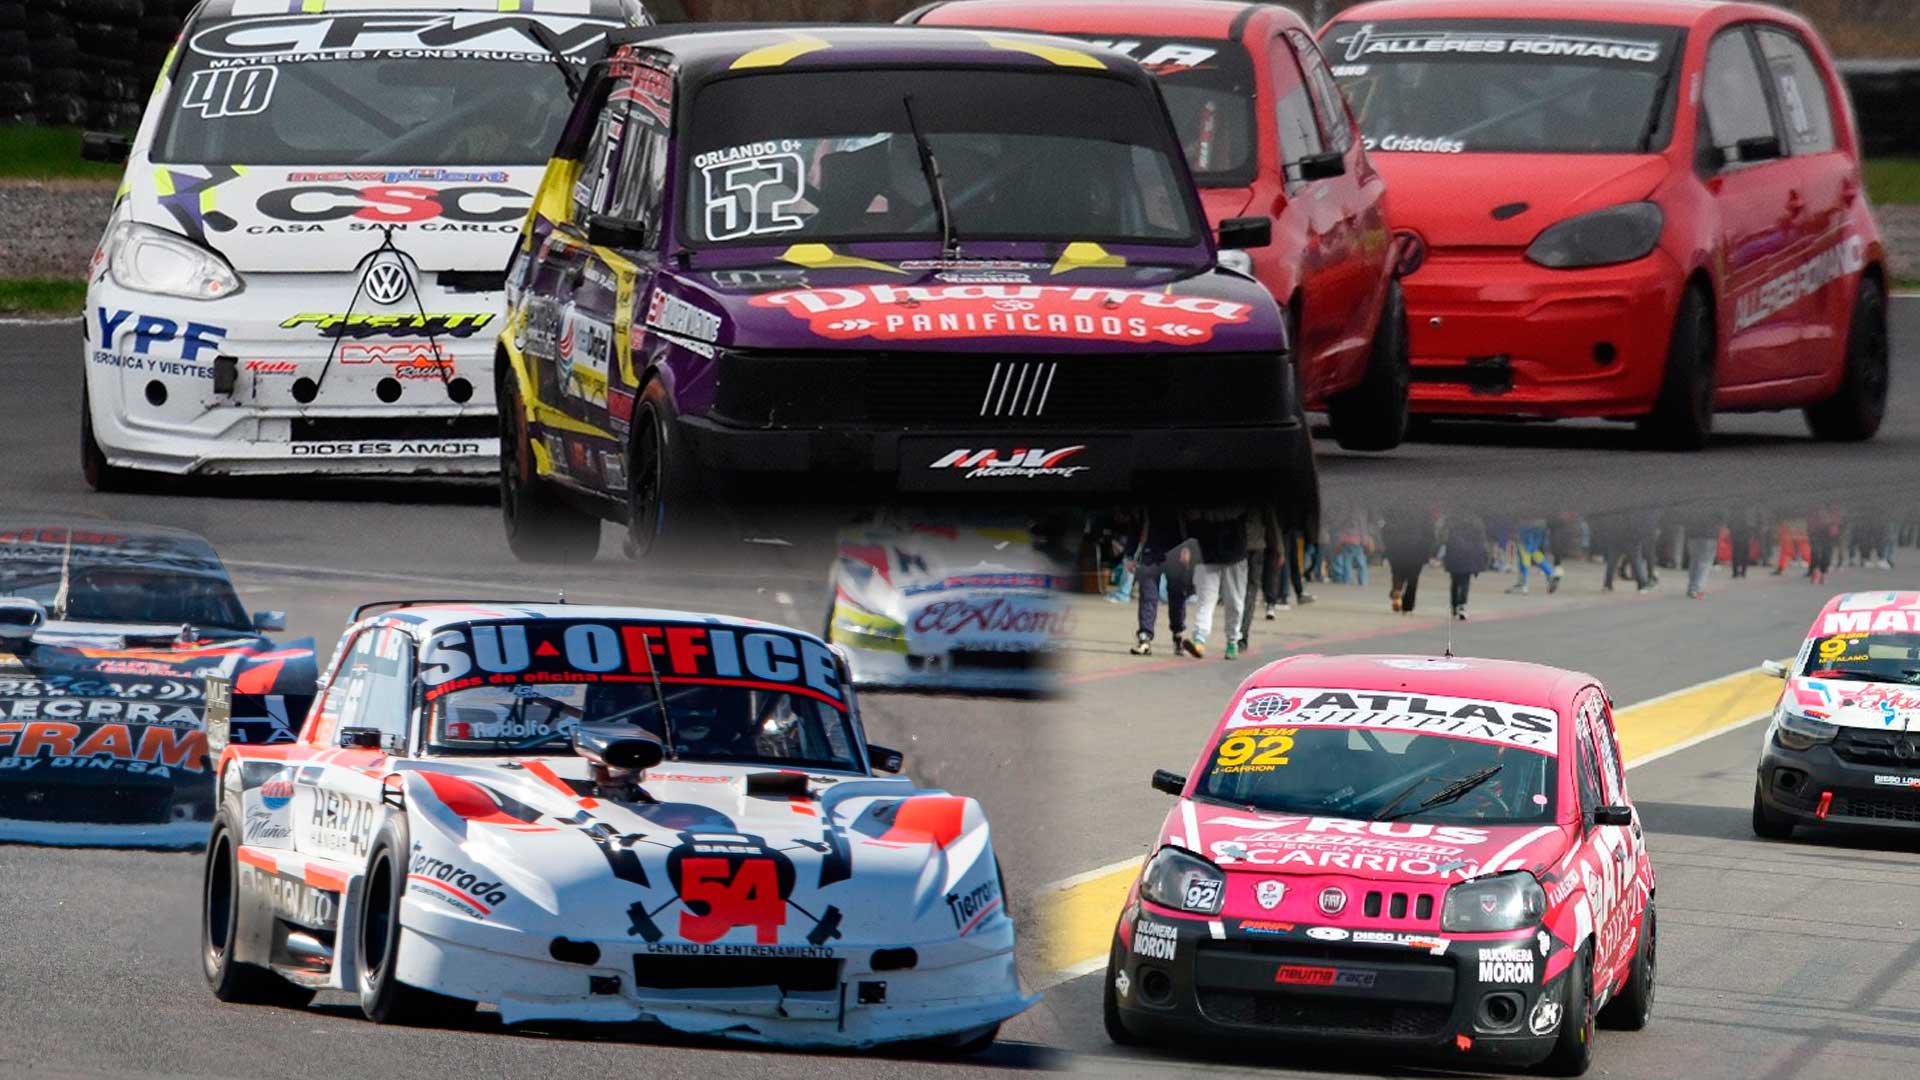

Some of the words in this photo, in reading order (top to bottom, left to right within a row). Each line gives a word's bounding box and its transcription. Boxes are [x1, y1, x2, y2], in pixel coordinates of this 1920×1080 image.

[210, 51, 366, 68] MATERIALES
[388, 49, 587, 66] CONSTRUCCIN
[1511, 37, 1658, 62] ROMANO
[182, 65, 280, 118] 40
[694, 141, 778, 169] ORLANDO
[1381, 134, 1465, 153] Cristales
[255, 185, 533, 223] CSC
[246, 224, 326, 235] CASA
[350, 223, 408, 232] SAN
[767, 285, 1249, 321] Dharma
[98, 306, 227, 361] YPF
[886, 312, 1147, 338] PANIFICADOS
[148, 360, 157, 371] Y
[159, 361, 218, 379] VIEYTES
[291, 444, 353, 455] DIOS
[358, 443, 392, 454] ES
[399, 443, 480, 454] AMOR
[1819, 638, 1847, 658] 9
[421, 624, 532, 687] SU
[563, 623, 842, 700] OFFICE
[488, 674, 517, 684] de
[523, 672, 599, 682] oficina
[1302, 692, 1554, 734] ATLAS
[473, 719, 550, 739] Rodolfo
[1288, 709, 1549, 746] SHIPPING
[1217, 735, 1294, 767] 92
[1250, 841, 1354, 853] AGENCIA
[679, 857, 788, 945] 54
[1185, 886, 1213, 909] 92
[1137, 919, 1178, 940] BULONERA
[1352, 931, 1394, 942] DIEGO
[647, 943, 699, 955] CENTRO
[703, 944, 721, 955] DE
[725, 945, 835, 959] ENTRENAMIENTO
[1133, 932, 1177, 960] MORON
[1478, 947, 1534, 962] BULONERA
[1478, 961, 1535, 984] MORON
